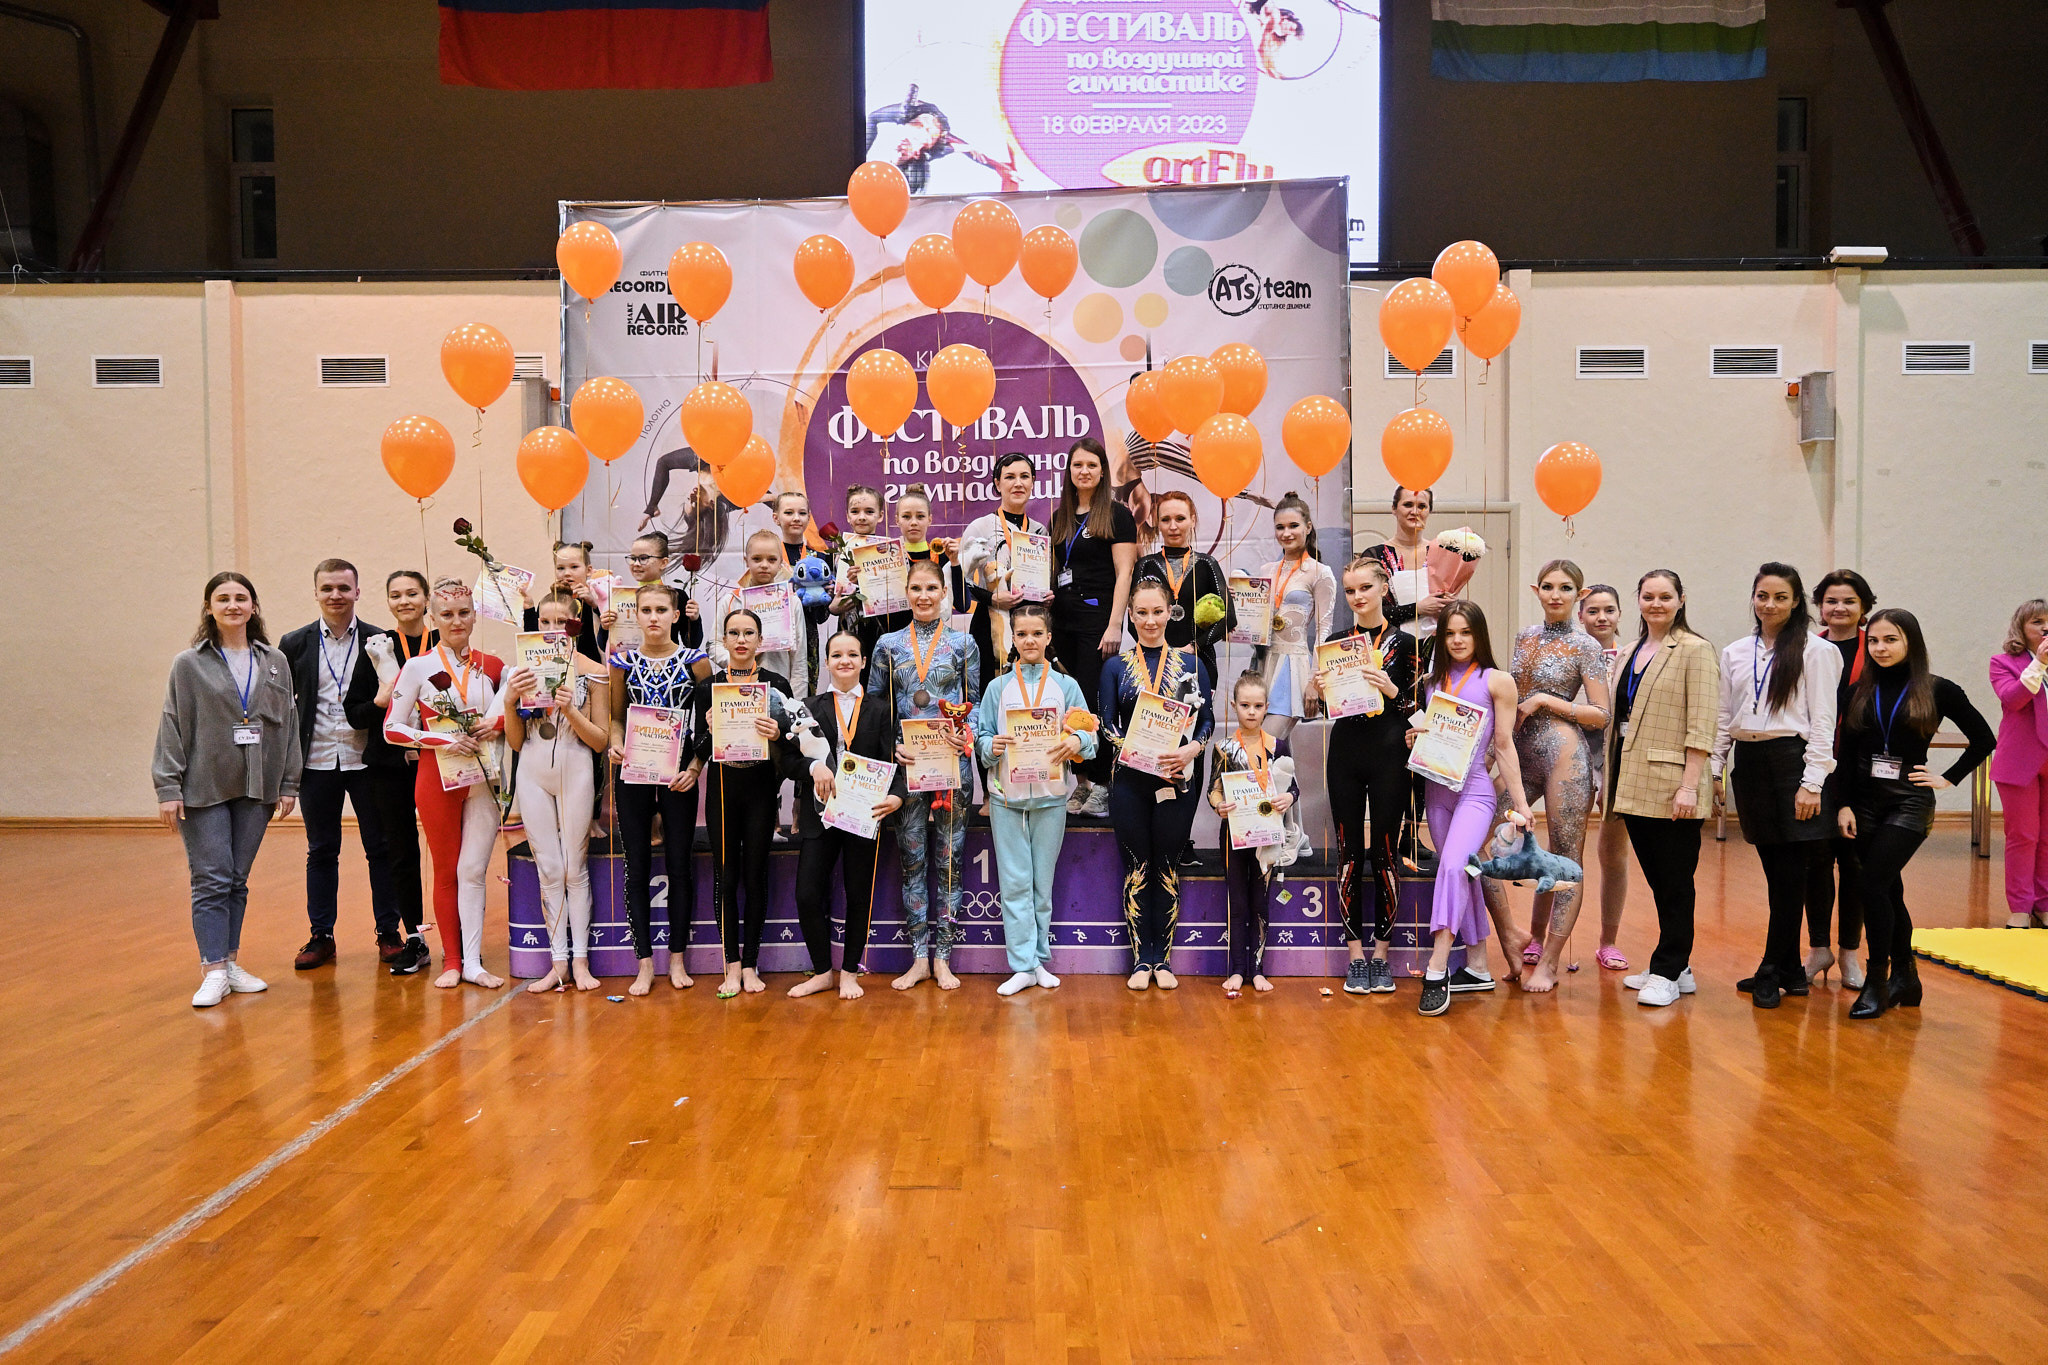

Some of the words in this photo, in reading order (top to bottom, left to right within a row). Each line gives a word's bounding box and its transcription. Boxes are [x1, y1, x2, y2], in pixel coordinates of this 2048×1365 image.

[1020, 8, 1246, 46] ФЕСТИВАЛЬ
[1067, 51, 1099, 69] по
[1103, 46, 1246, 73] воздушной
[1067, 69, 1246, 93] гимнастике
[1042, 115, 1064, 134] 18
[1069, 114, 1171, 134] ФЕВРАЛЯ
[1178, 114, 1227, 134] 2023
[609, 280, 666, 293] ECORD
[1263, 277, 1312, 299] team
[634, 303, 688, 324] AIR
[627, 324, 688, 336] RECORD
[828, 405, 1090, 449] ФСТВАЛЬ
[883, 456, 920, 475] по
[924, 450, 1069, 479] воздно
[862, 557, 893, 568] ГРАМОТА
[878, 560, 903, 571] МЕСТО
[535, 655, 542, 667] 3
[1325, 654, 1359, 667] ГРАМОТА
[1335, 665, 1344, 676] 2
[1343, 658, 1369, 669] МЕСТО
[730, 707, 734, 719] 1
[736, 706, 764, 714] МЕСТО
[1141, 708, 1173, 724] ГРАМОТА
[1433, 712, 1466, 728] ГРАМОТА
[632, 725, 672, 736] ДИПЛОМ
[1147, 718, 1153, 728] 1
[1154, 719, 1179, 733] МЕСТО
[1440, 722, 1445, 733] 1
[1447, 724, 1473, 737] МЕСТО
[639, 732, 674, 741] УЧАСТНИКА
[1022, 731, 1029, 742] 2
[1030, 729, 1056, 737] МЕСТО
[921, 740, 927, 751] 3
[1243, 795, 1248, 806] 1
[973, 849, 988, 884] 1
[649, 875, 669, 908] 2
[1302, 886, 1323, 918] 3
